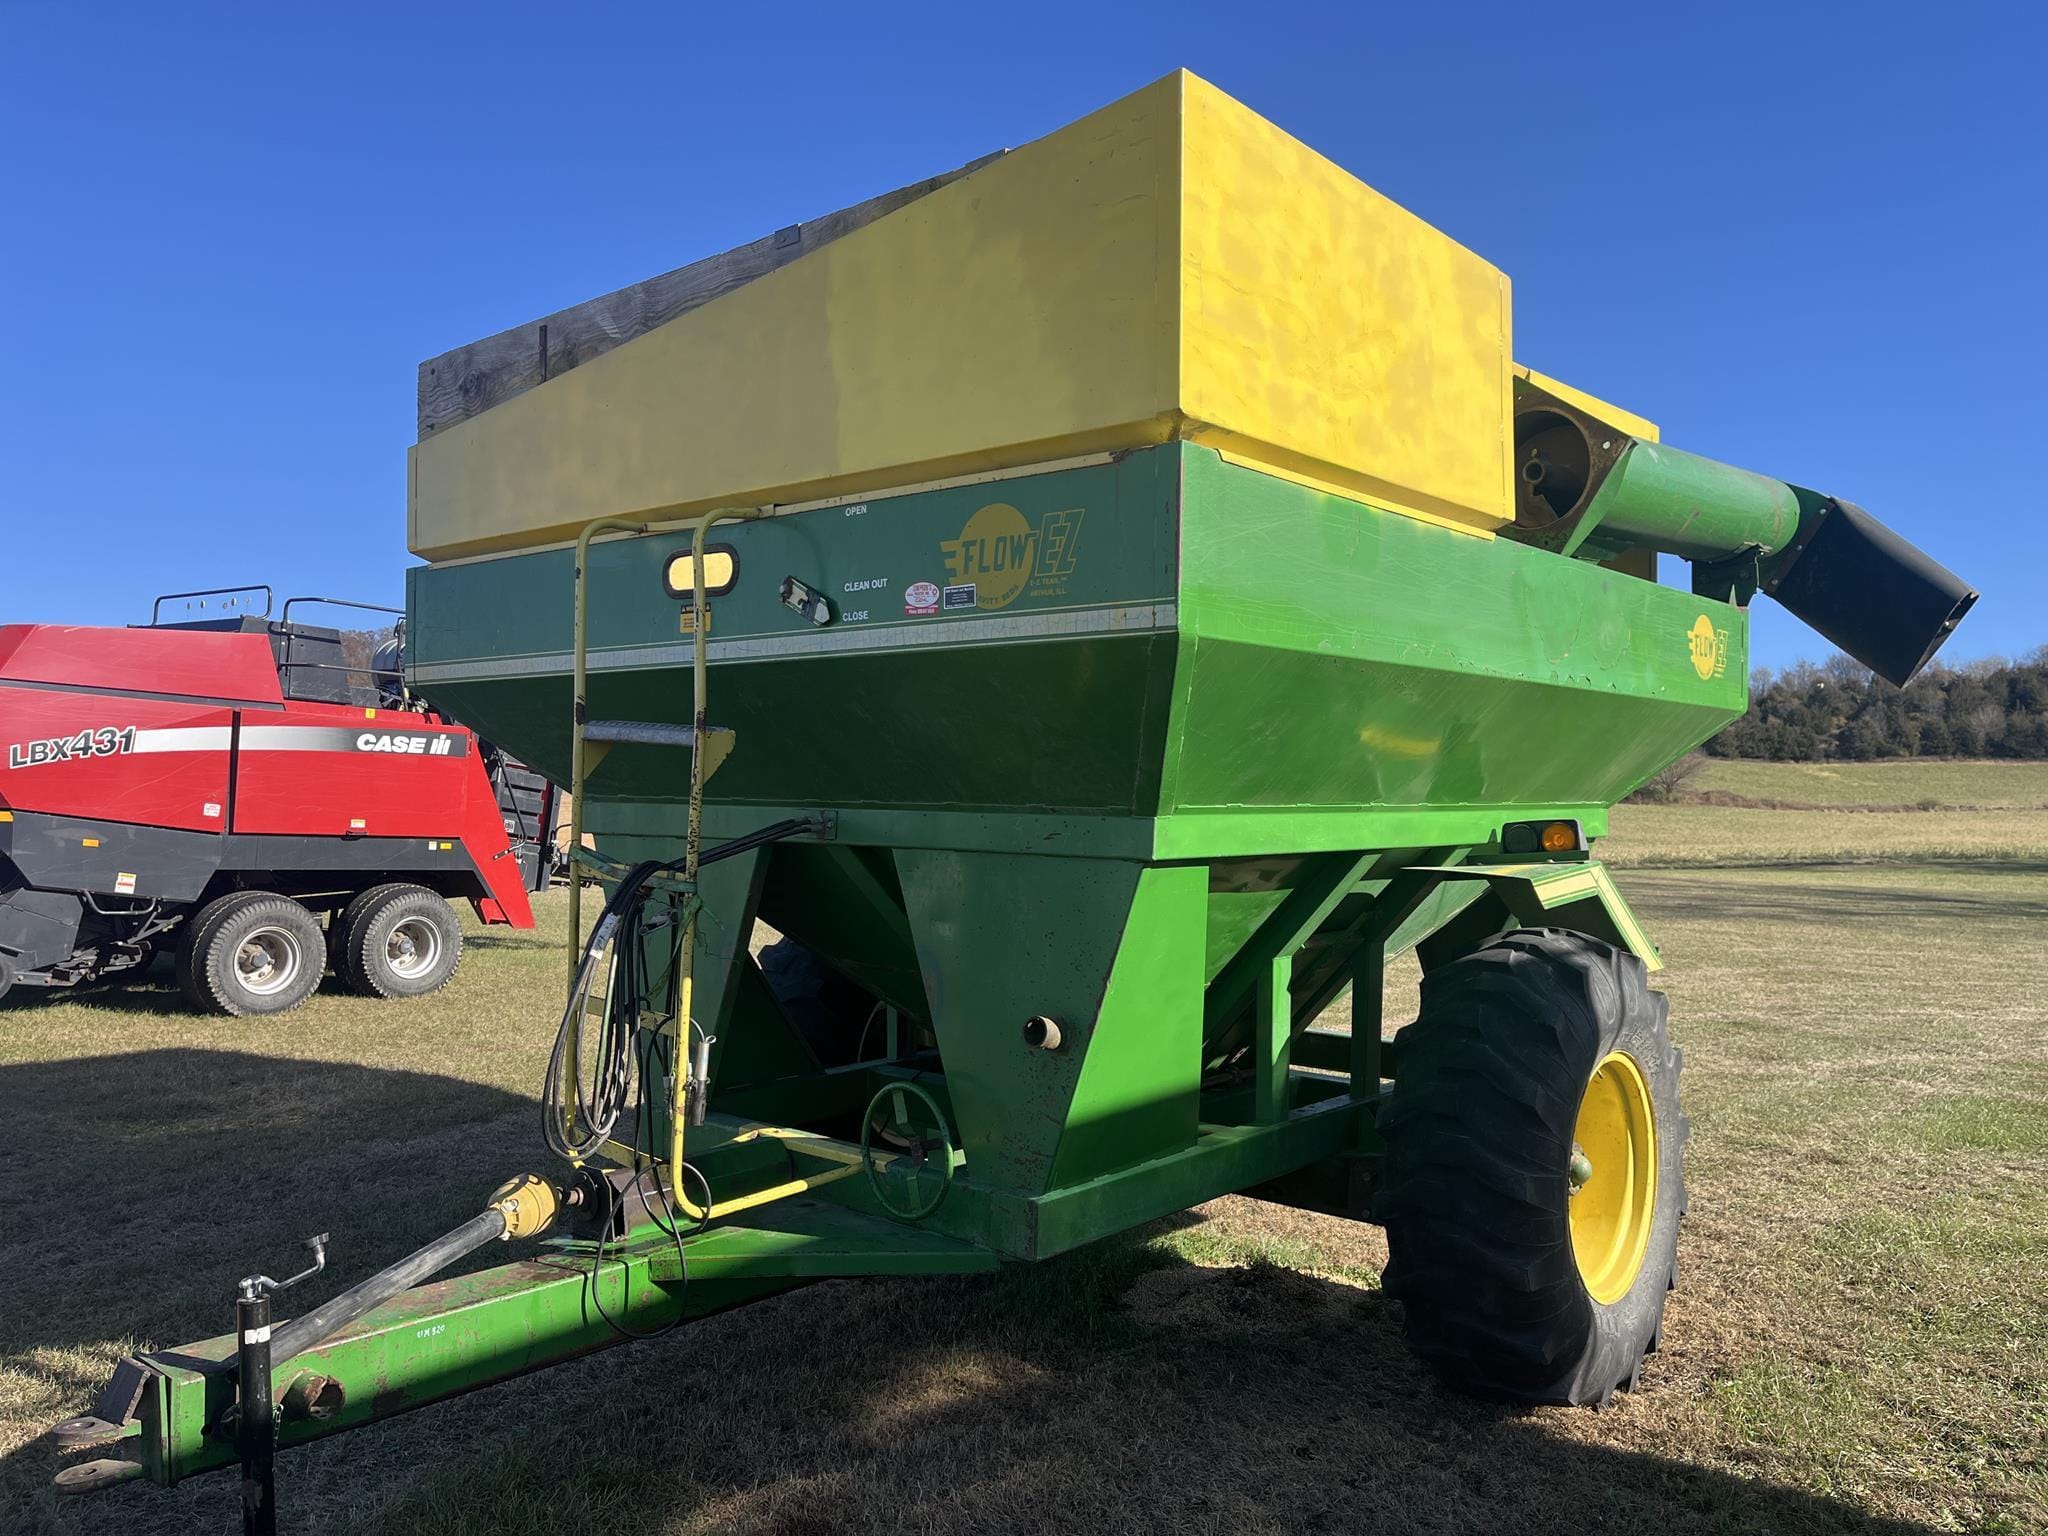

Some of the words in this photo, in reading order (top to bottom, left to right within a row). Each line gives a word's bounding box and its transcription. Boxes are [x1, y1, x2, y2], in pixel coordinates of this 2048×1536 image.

[845, 504, 867, 517] OPEN
[961, 530, 1037, 577] FLOW
[1035, 508, 1086, 577] EZ
[844, 580, 870, 592] CLEAN
[871, 578, 888, 589] OUT
[842, 610, 869, 622] CLOSE
[1693, 632, 1715, 659] FLOW
[9, 725, 136, 769] LBX431
[356, 733, 427, 754] CASE
